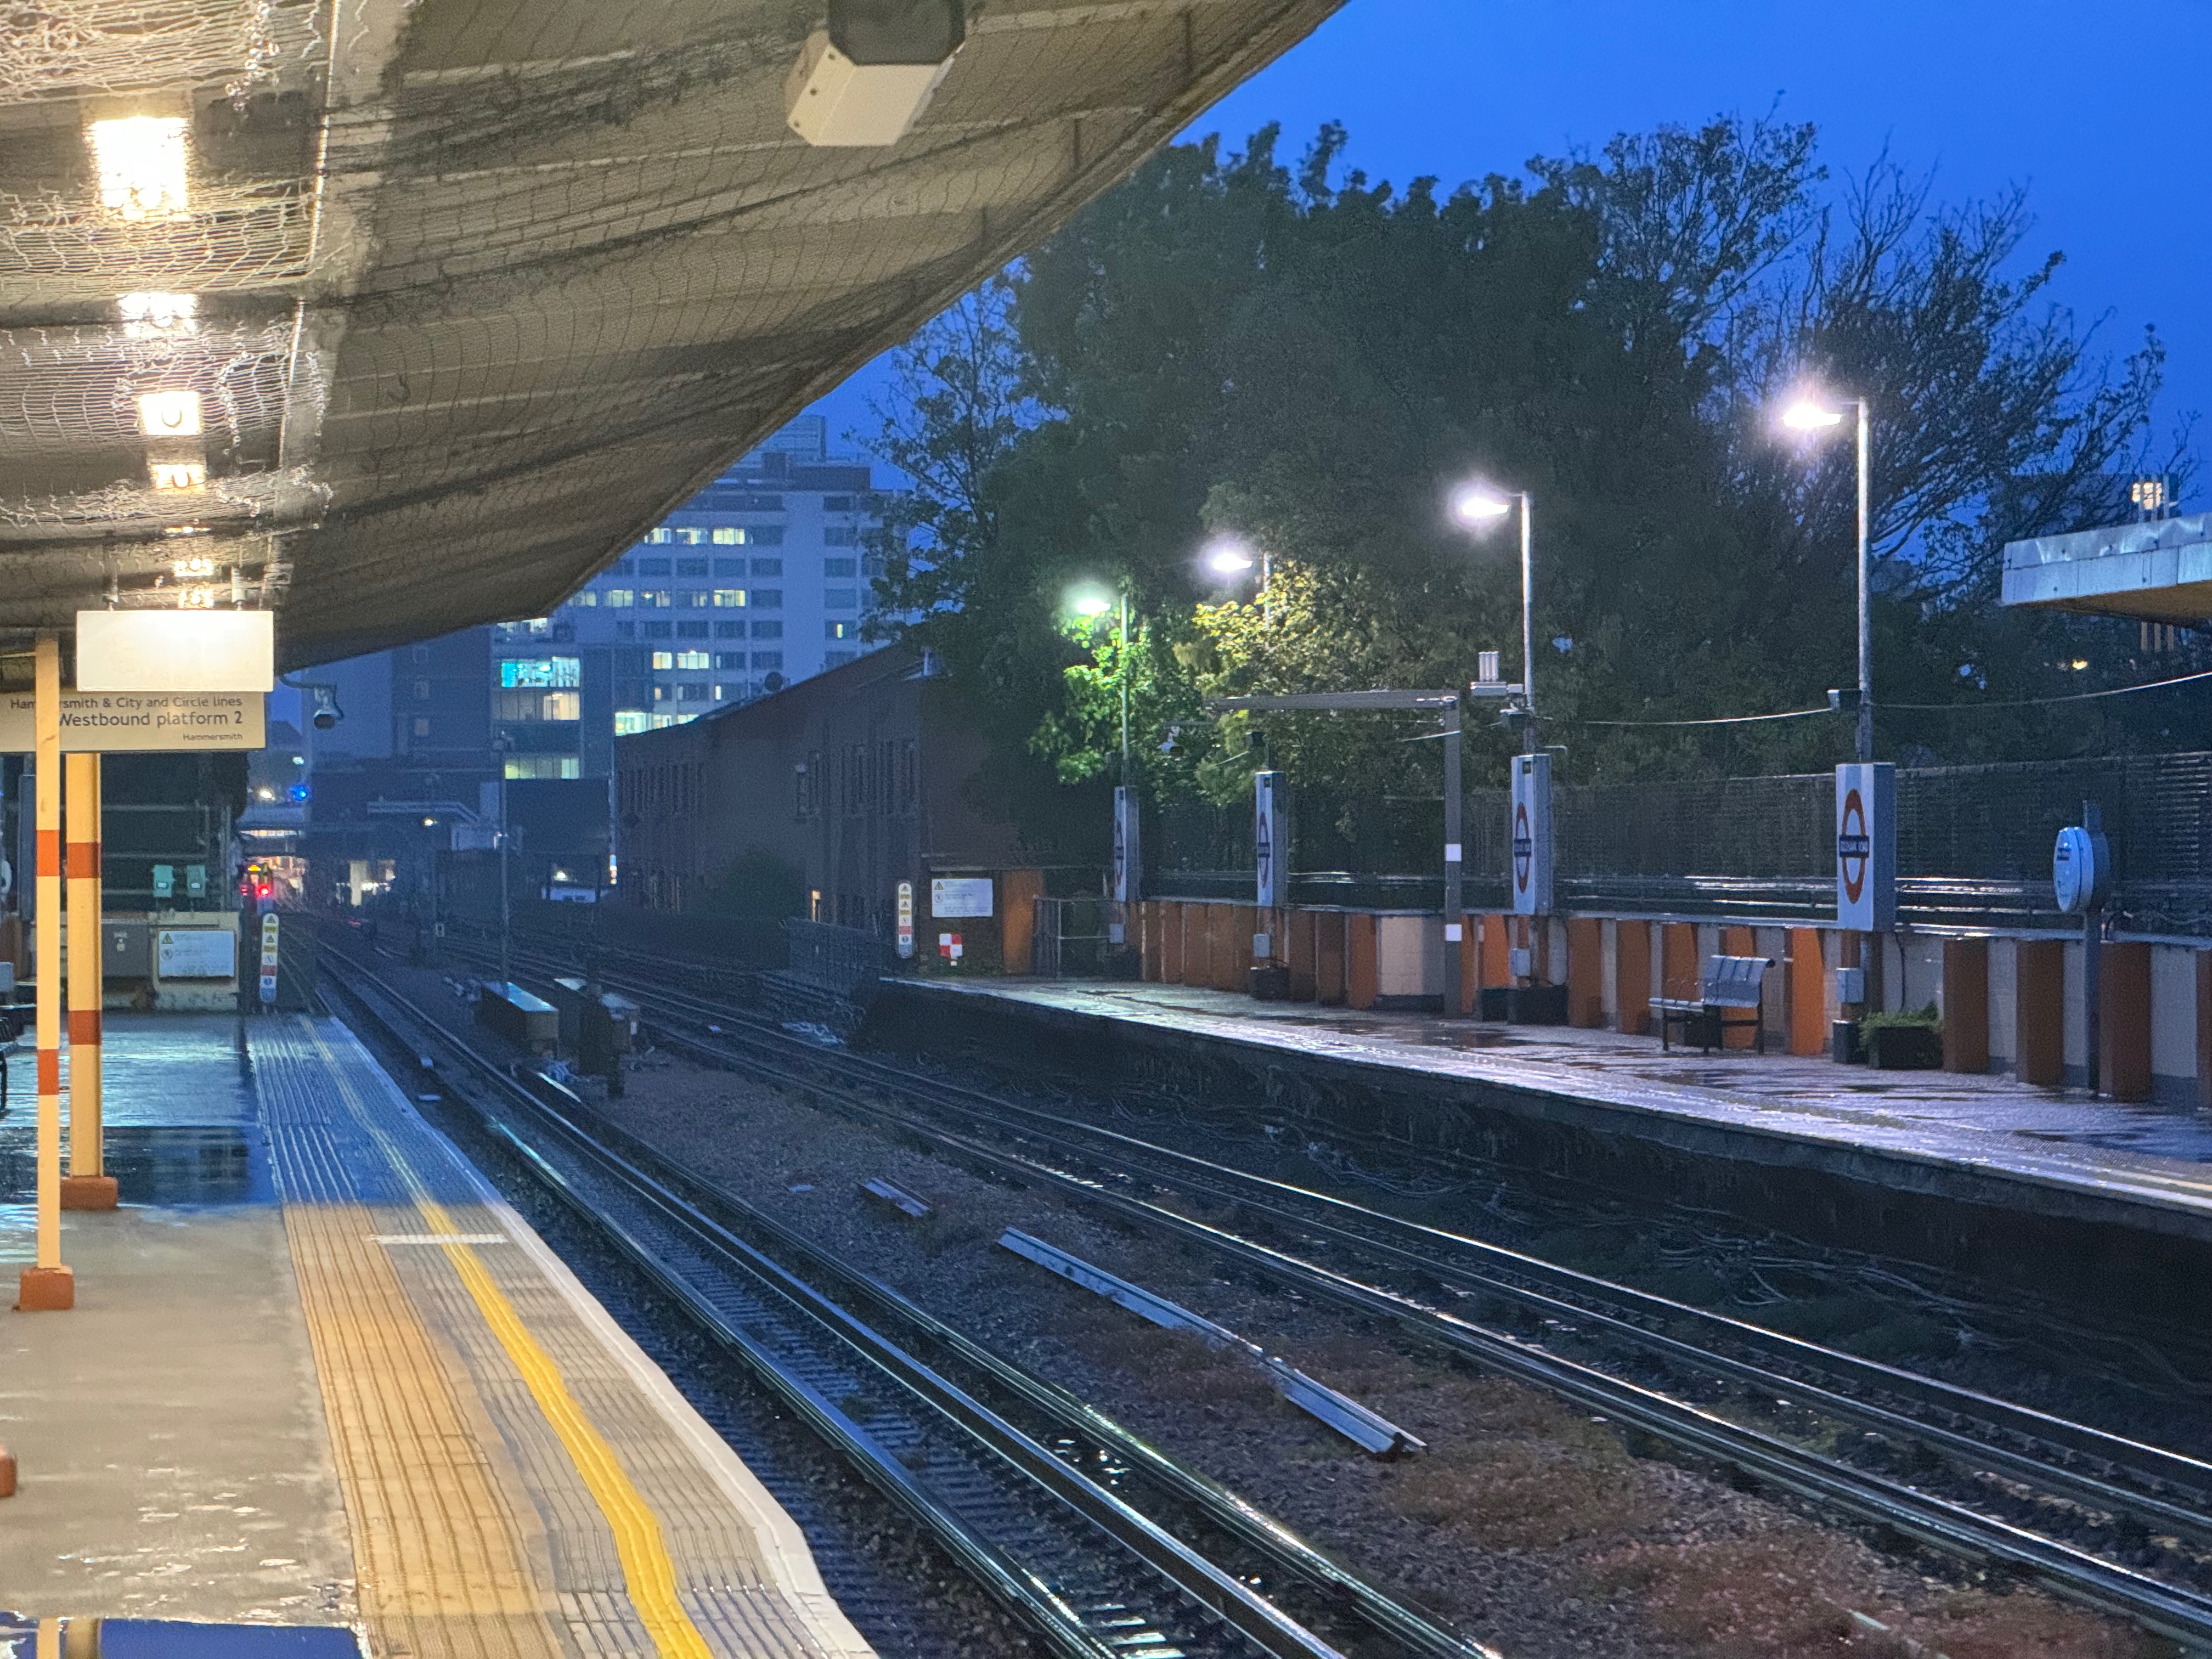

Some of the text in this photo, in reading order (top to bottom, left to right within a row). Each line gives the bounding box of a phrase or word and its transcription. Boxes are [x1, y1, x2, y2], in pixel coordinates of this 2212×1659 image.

[103, 697, 111, 708] &
[116, 697, 142, 710] City
[146, 697, 168, 708] and
[173, 697, 208, 707] Circle
[213, 696, 242, 707] lines
[59, 710, 243, 729] Westbound platform 2
